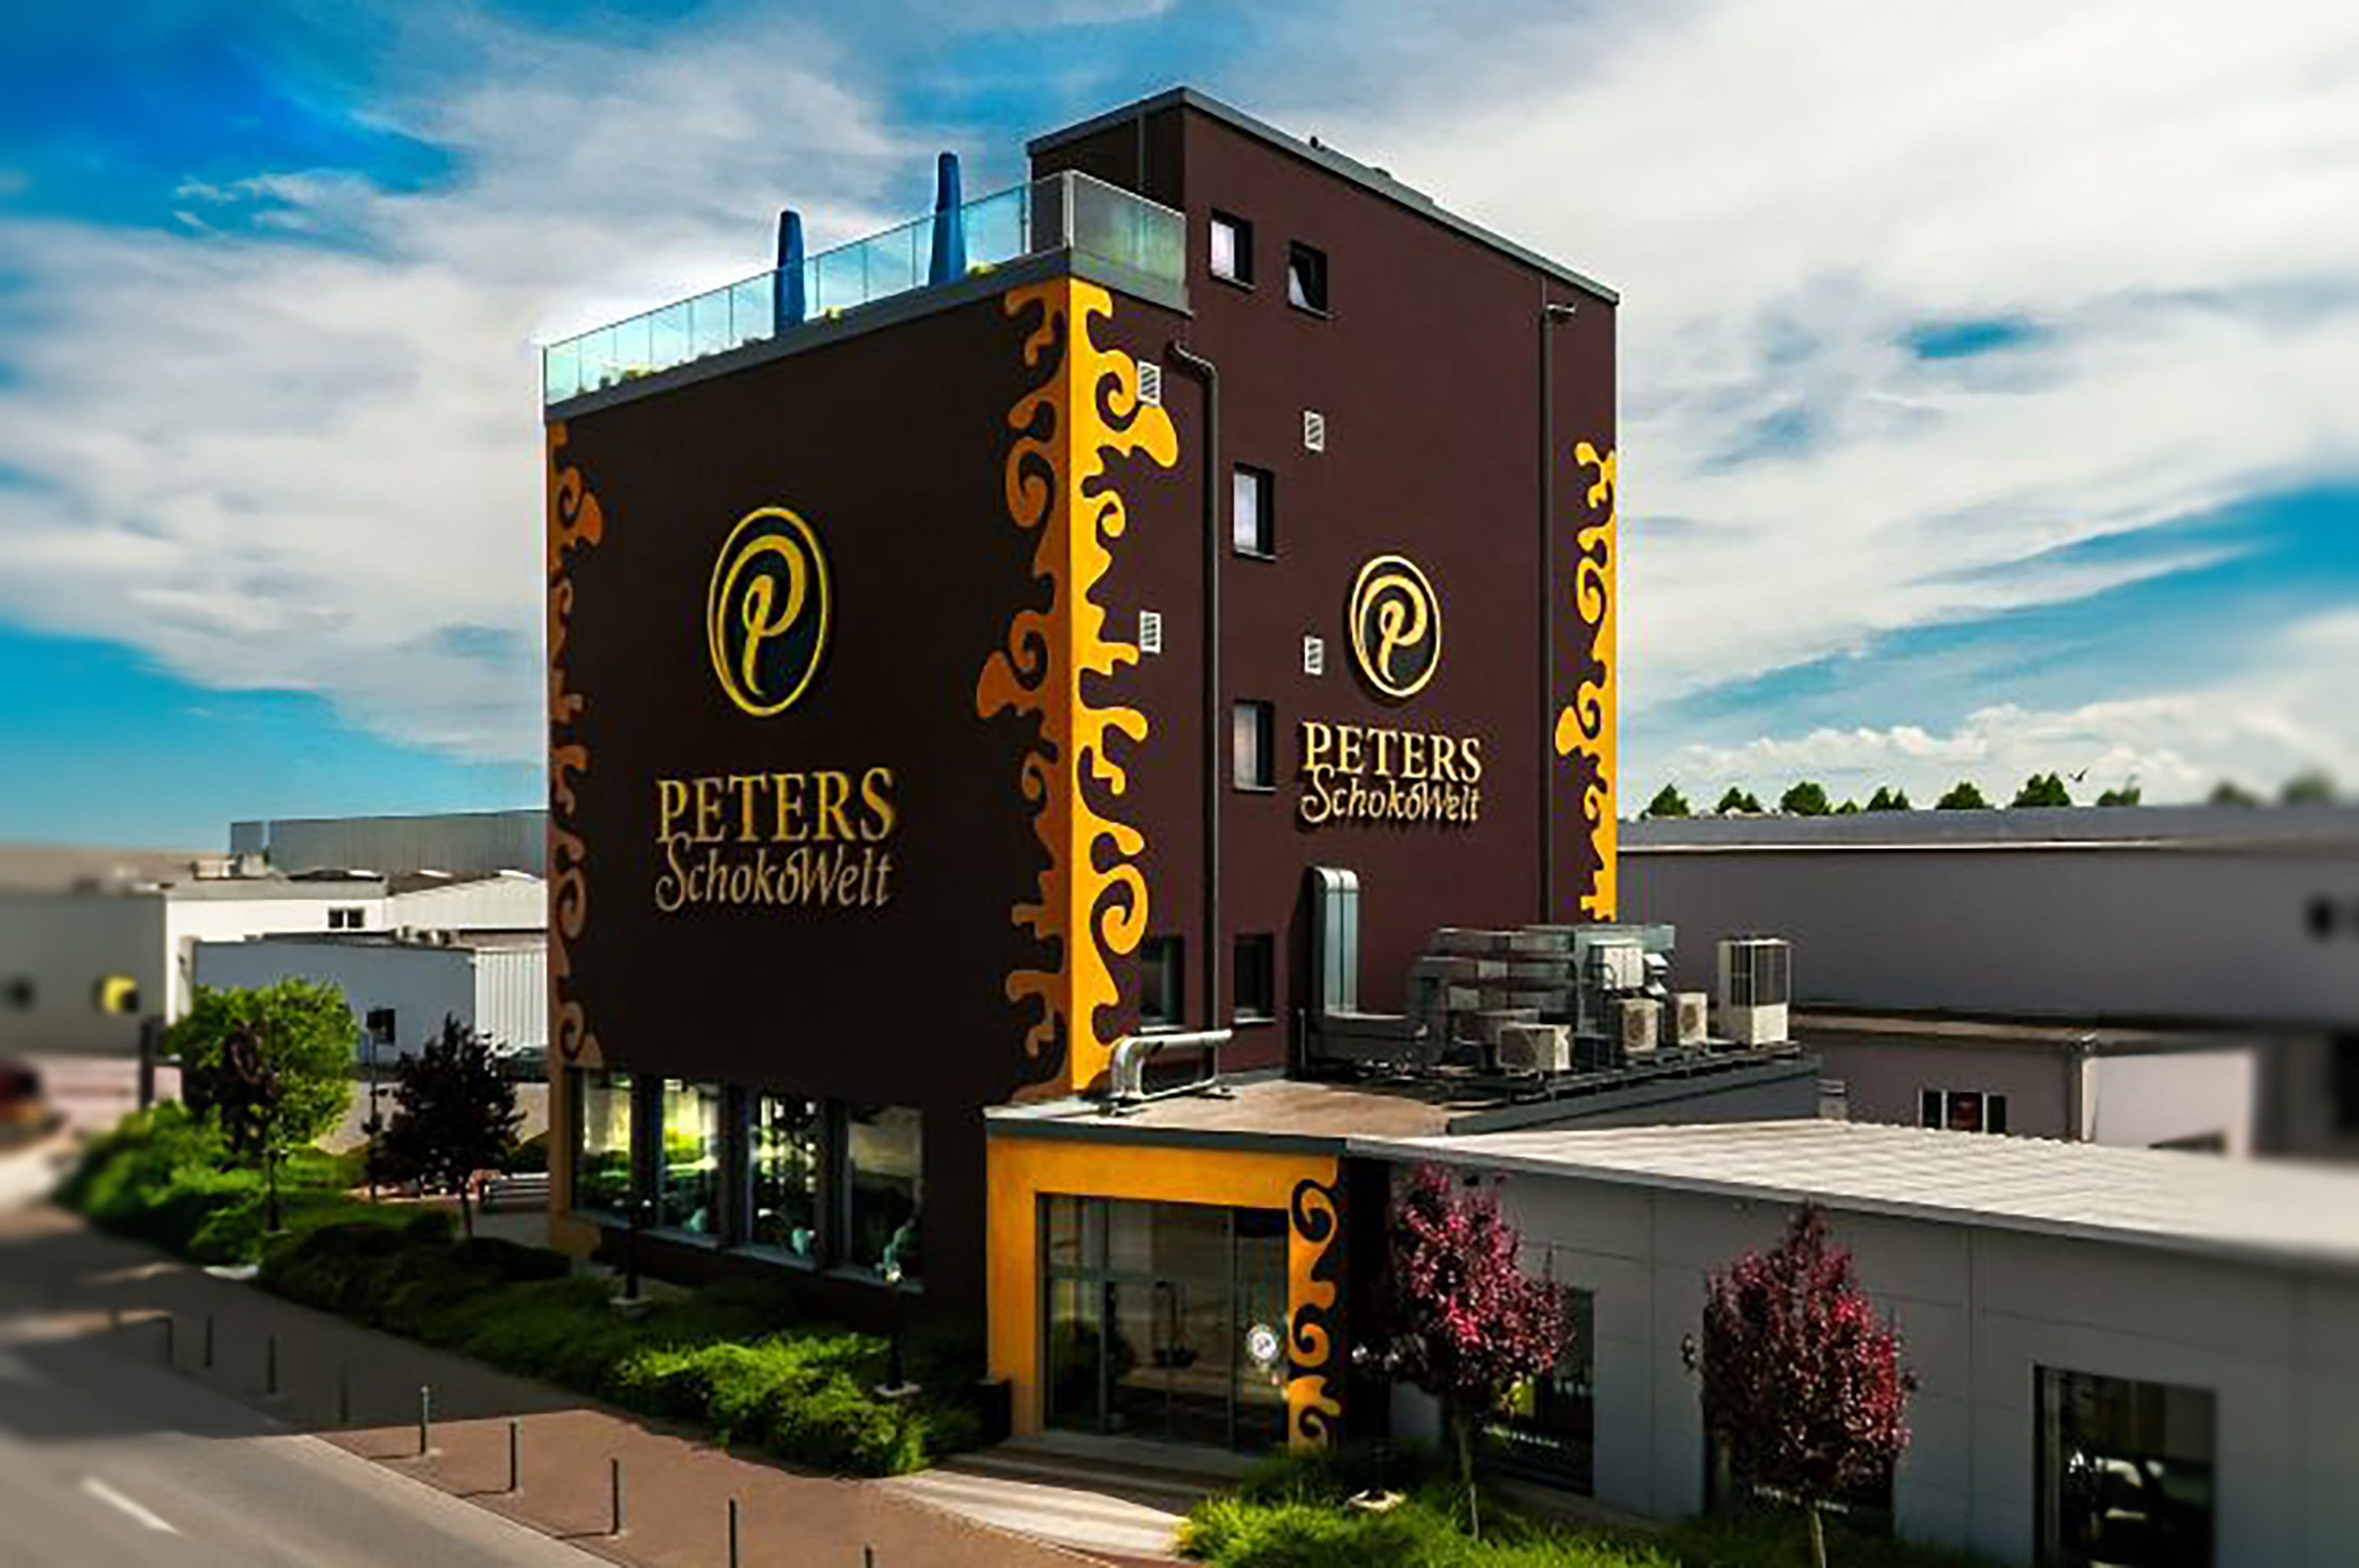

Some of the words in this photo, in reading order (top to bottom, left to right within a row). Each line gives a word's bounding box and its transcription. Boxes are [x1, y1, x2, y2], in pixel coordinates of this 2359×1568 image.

[1302, 722, 1482, 783] PETERS
[656, 766, 894, 843] PETERS
[1301, 764, 1479, 823] SchokoWelt
[655, 832, 894, 911] SchokoWelt
